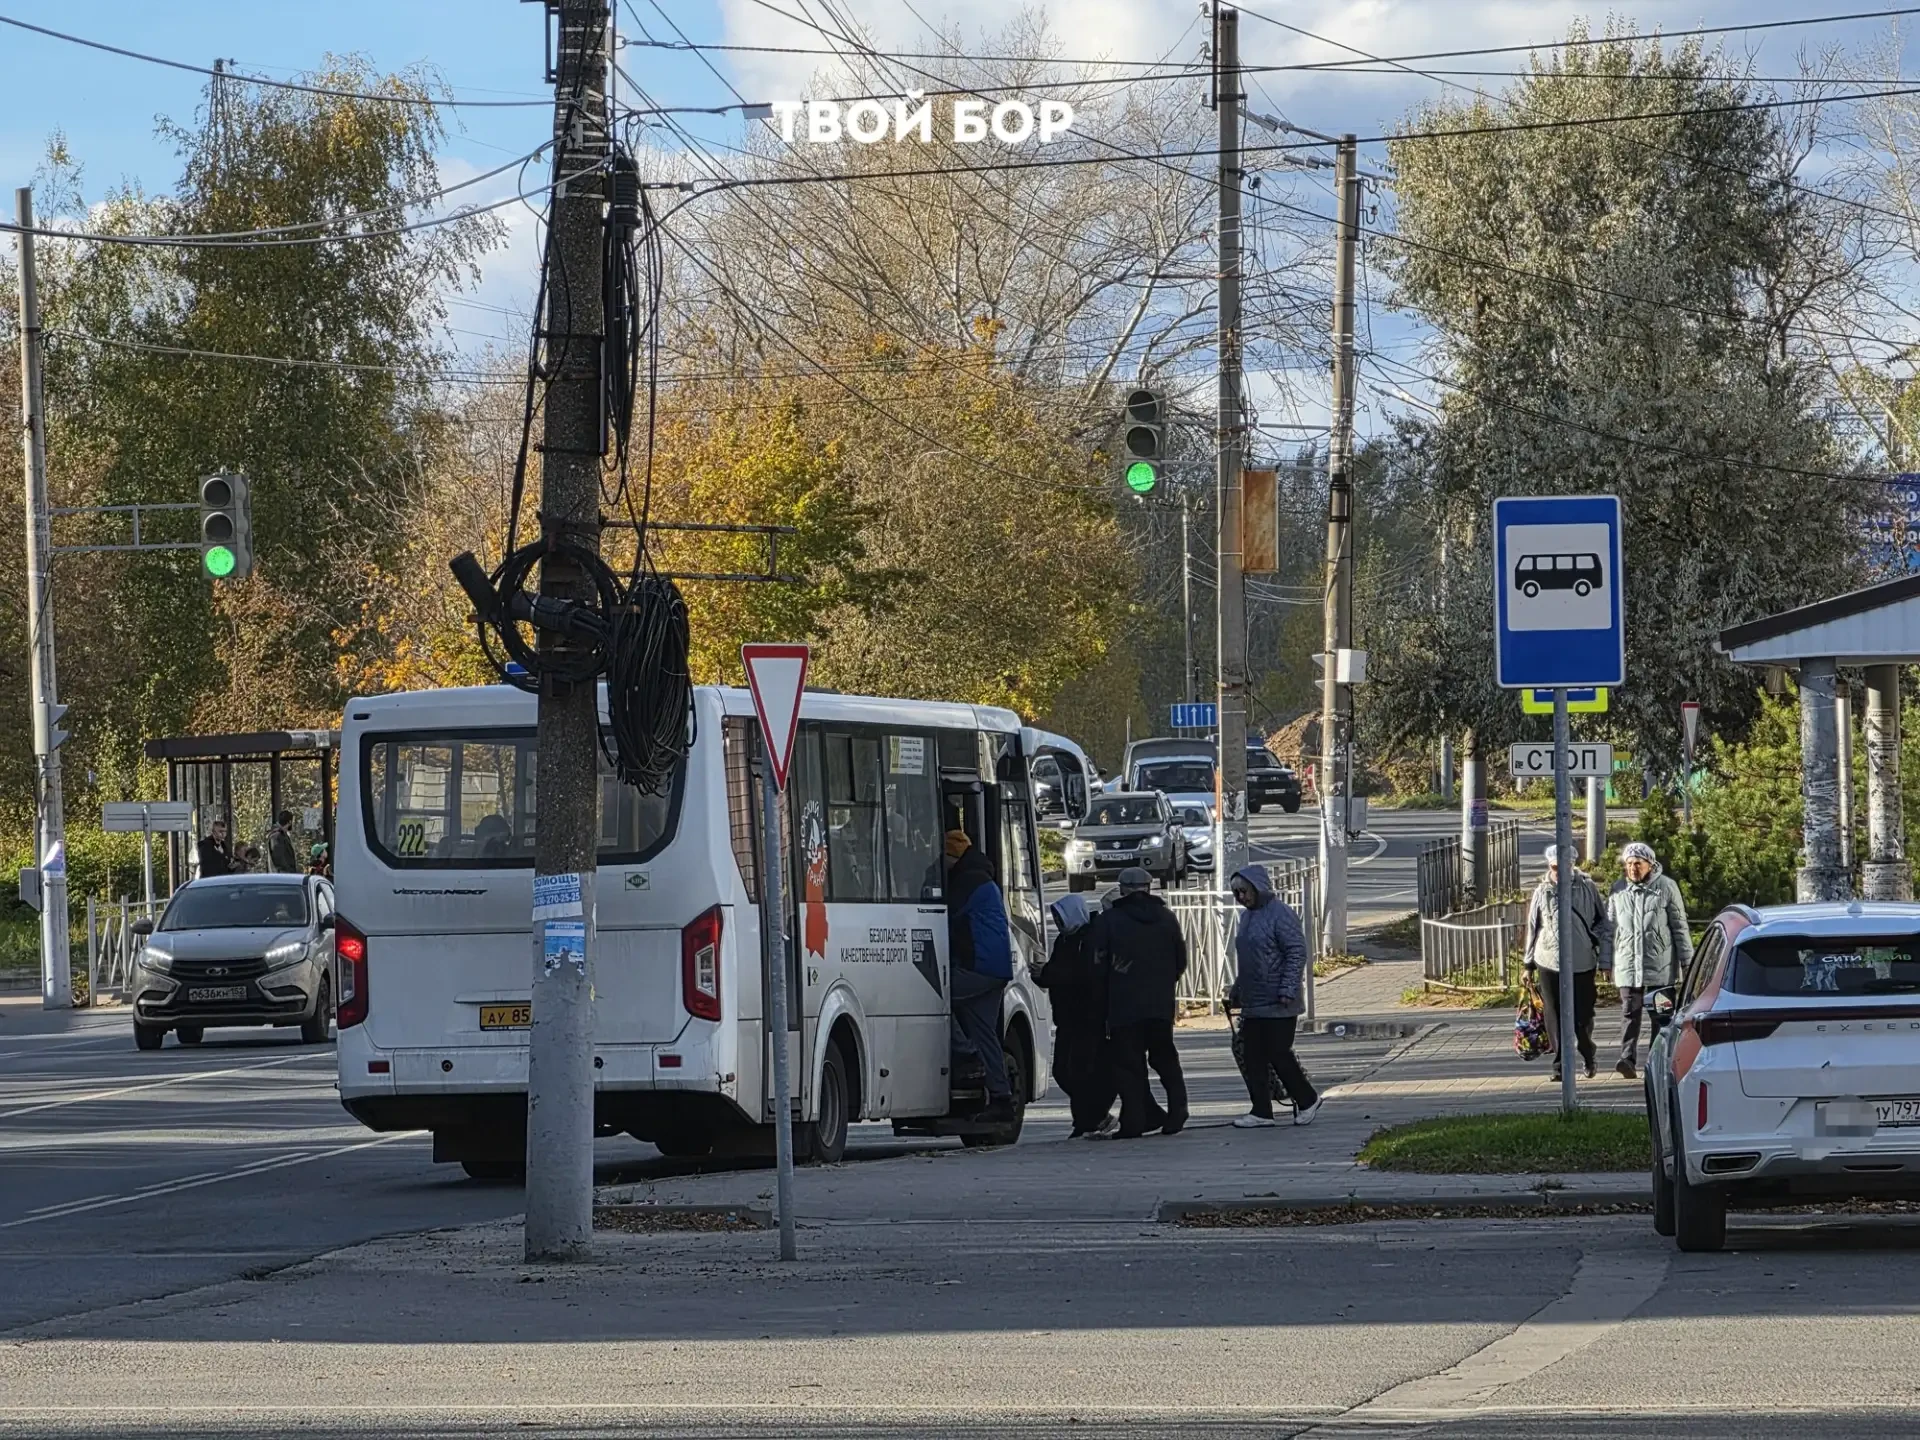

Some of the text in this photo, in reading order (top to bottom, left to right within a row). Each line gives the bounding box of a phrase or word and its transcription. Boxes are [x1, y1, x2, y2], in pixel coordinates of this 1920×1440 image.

[1527, 749, 1597, 771] СТОП
[398, 823, 424, 857] 222
[869, 928, 907, 943] БЕЗОПАСНЫЕ
[841, 947, 885, 963] КАЧЕСТВЕННЫЕ
[886, 947, 908, 966] ДОРОГИ
[488, 1008, 530, 1024] АУ 85
[1817, 1022, 1920, 1032] EXEED
